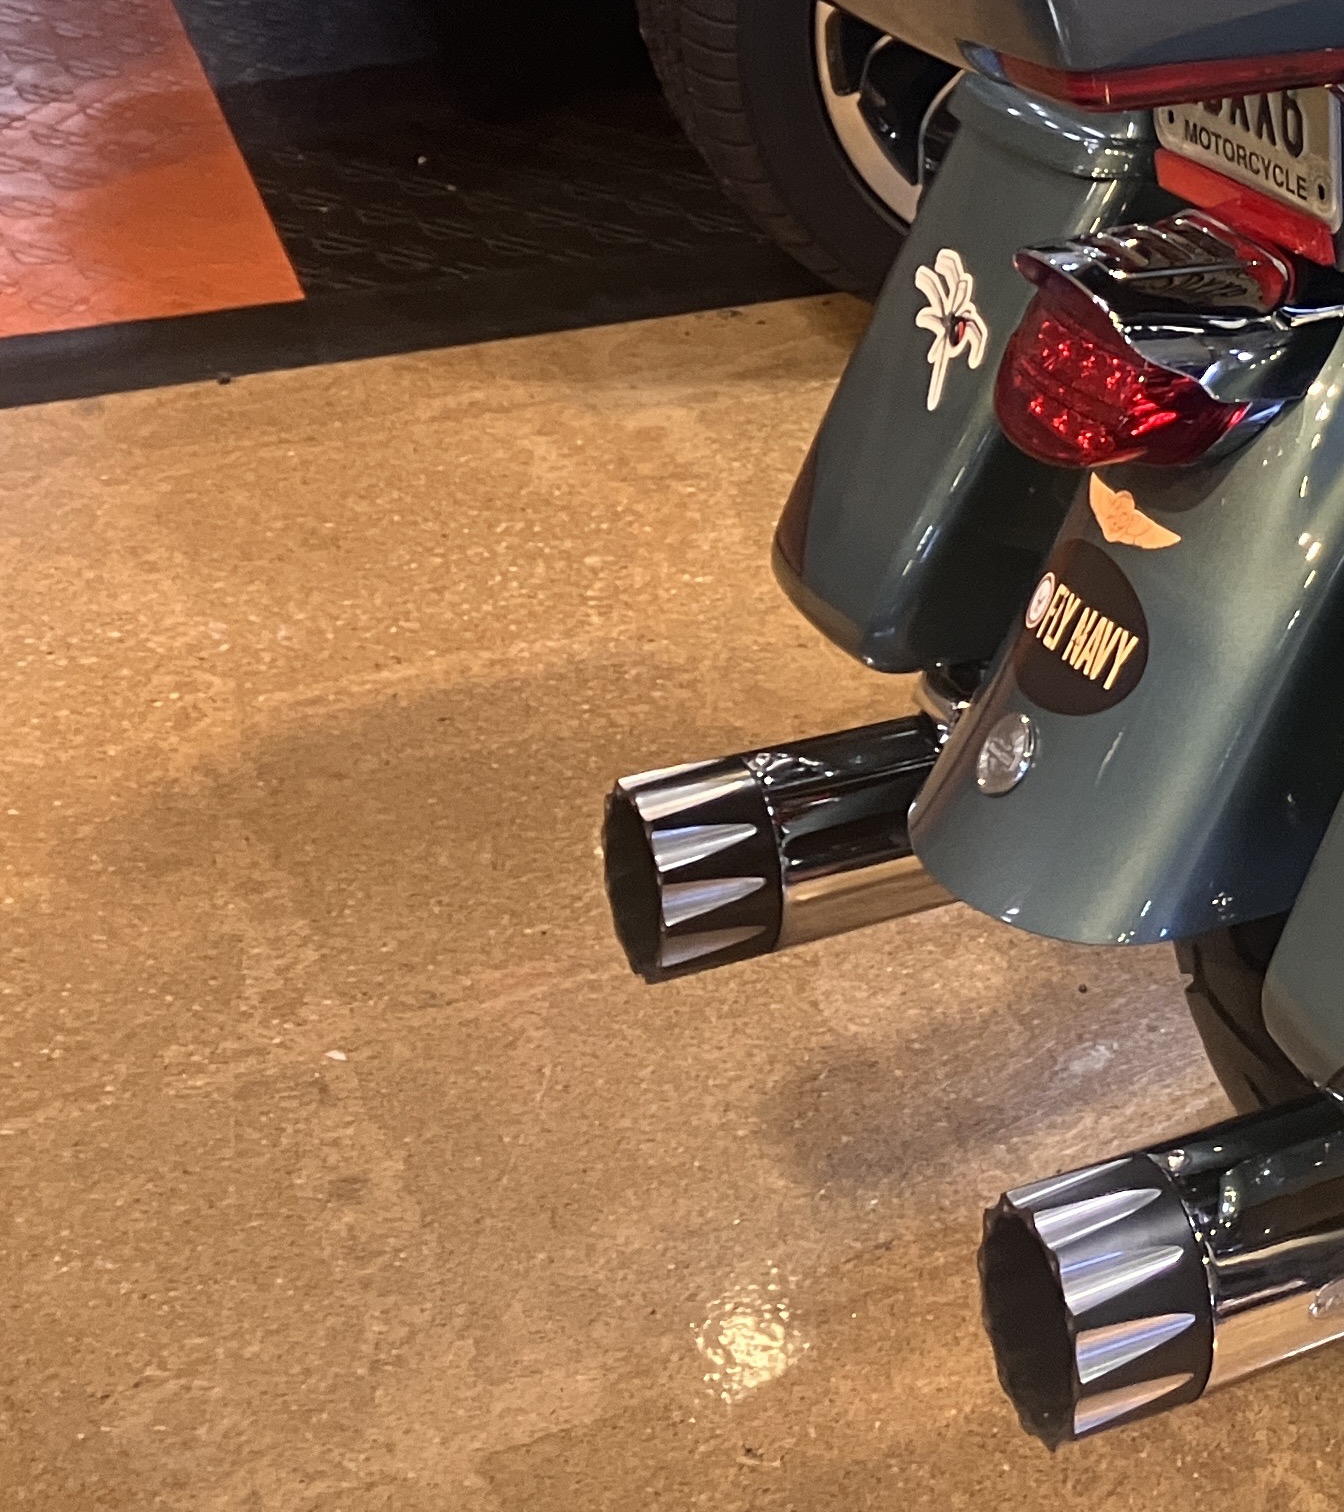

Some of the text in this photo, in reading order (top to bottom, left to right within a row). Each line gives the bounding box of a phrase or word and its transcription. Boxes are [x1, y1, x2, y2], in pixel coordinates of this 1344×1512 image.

[1184, 119, 1308, 200] MOTORCYCLE
[1035, 583, 1140, 691] FLY NAVY
